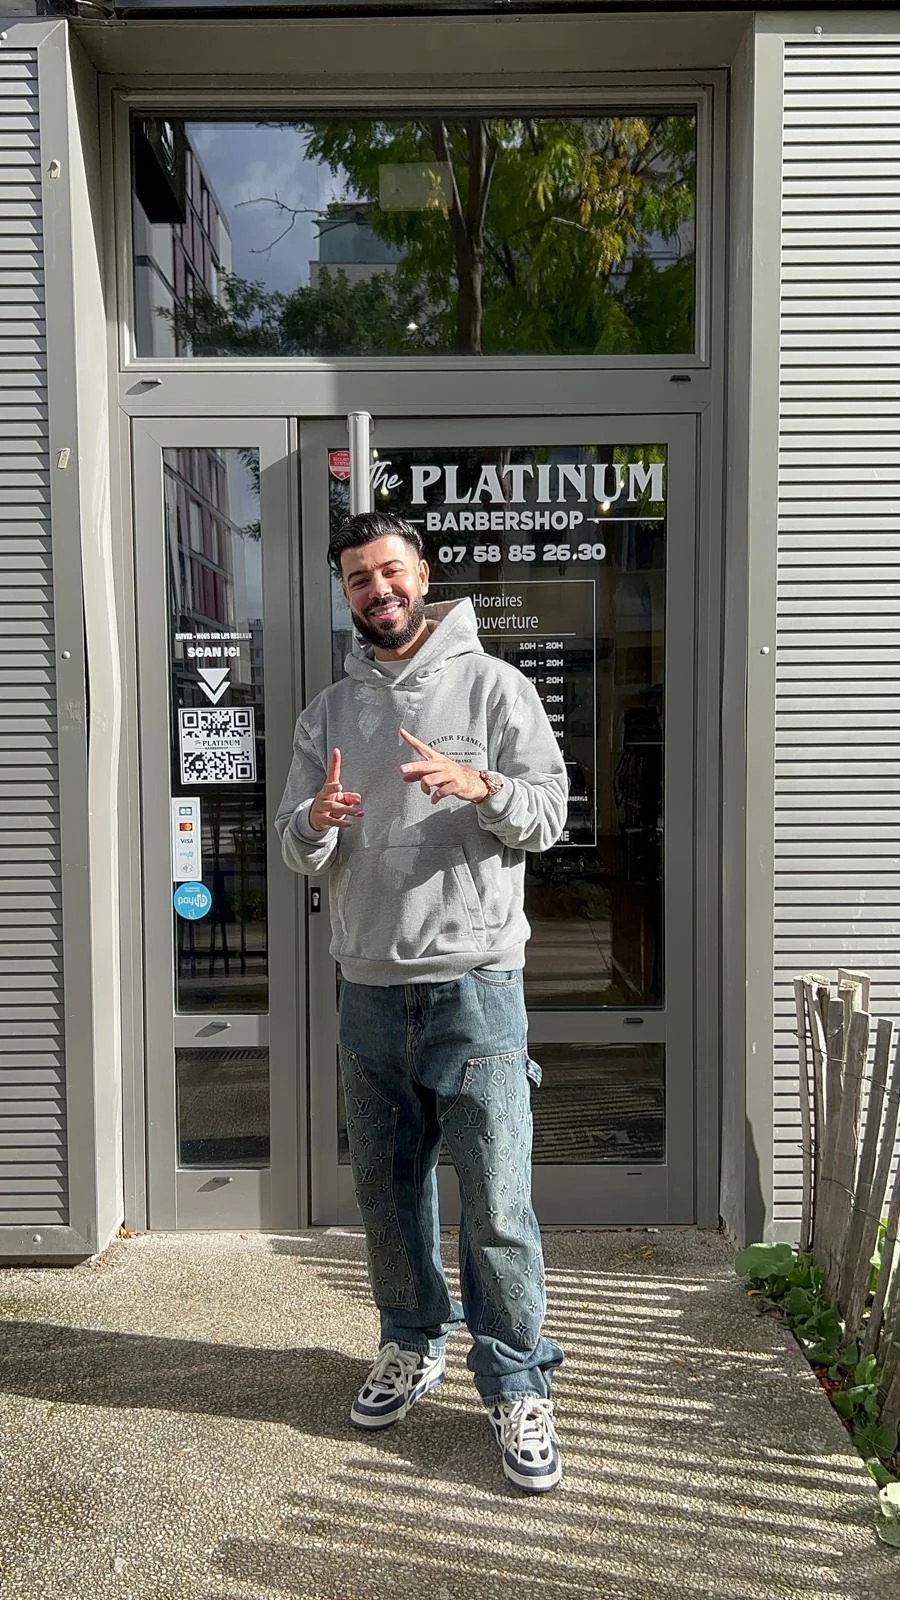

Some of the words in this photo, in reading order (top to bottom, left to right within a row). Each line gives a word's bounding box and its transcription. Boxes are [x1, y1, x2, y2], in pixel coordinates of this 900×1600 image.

[369, 461, 403, 489] The
[410, 464, 664, 504] PLATINUM
[426, 511, 584, 531] BARBERSHOP
[438, 546, 466, 563] 07
[473, 545, 501, 562] 58
[508, 544, 536, 562] 85
[542, 544, 571, 561] 26
[577, 543, 606, 560] 30
[473, 594, 522, 607] Horaires
[476, 614, 539, 629] ouverture
[519, 642, 536, 650] 10H
[545, 641, 563, 650] 20H
[187, 647, 221, 658] SCAN
[223, 646, 240, 657] ICI
[519, 659, 536, 668] 10H
[546, 659, 563, 667] 20H
[546, 676, 563, 684] 20H
[546, 695, 563, 703] 20H
[202, 739, 240, 747] PLATINUM
[428, 735, 453, 748] TELIER
